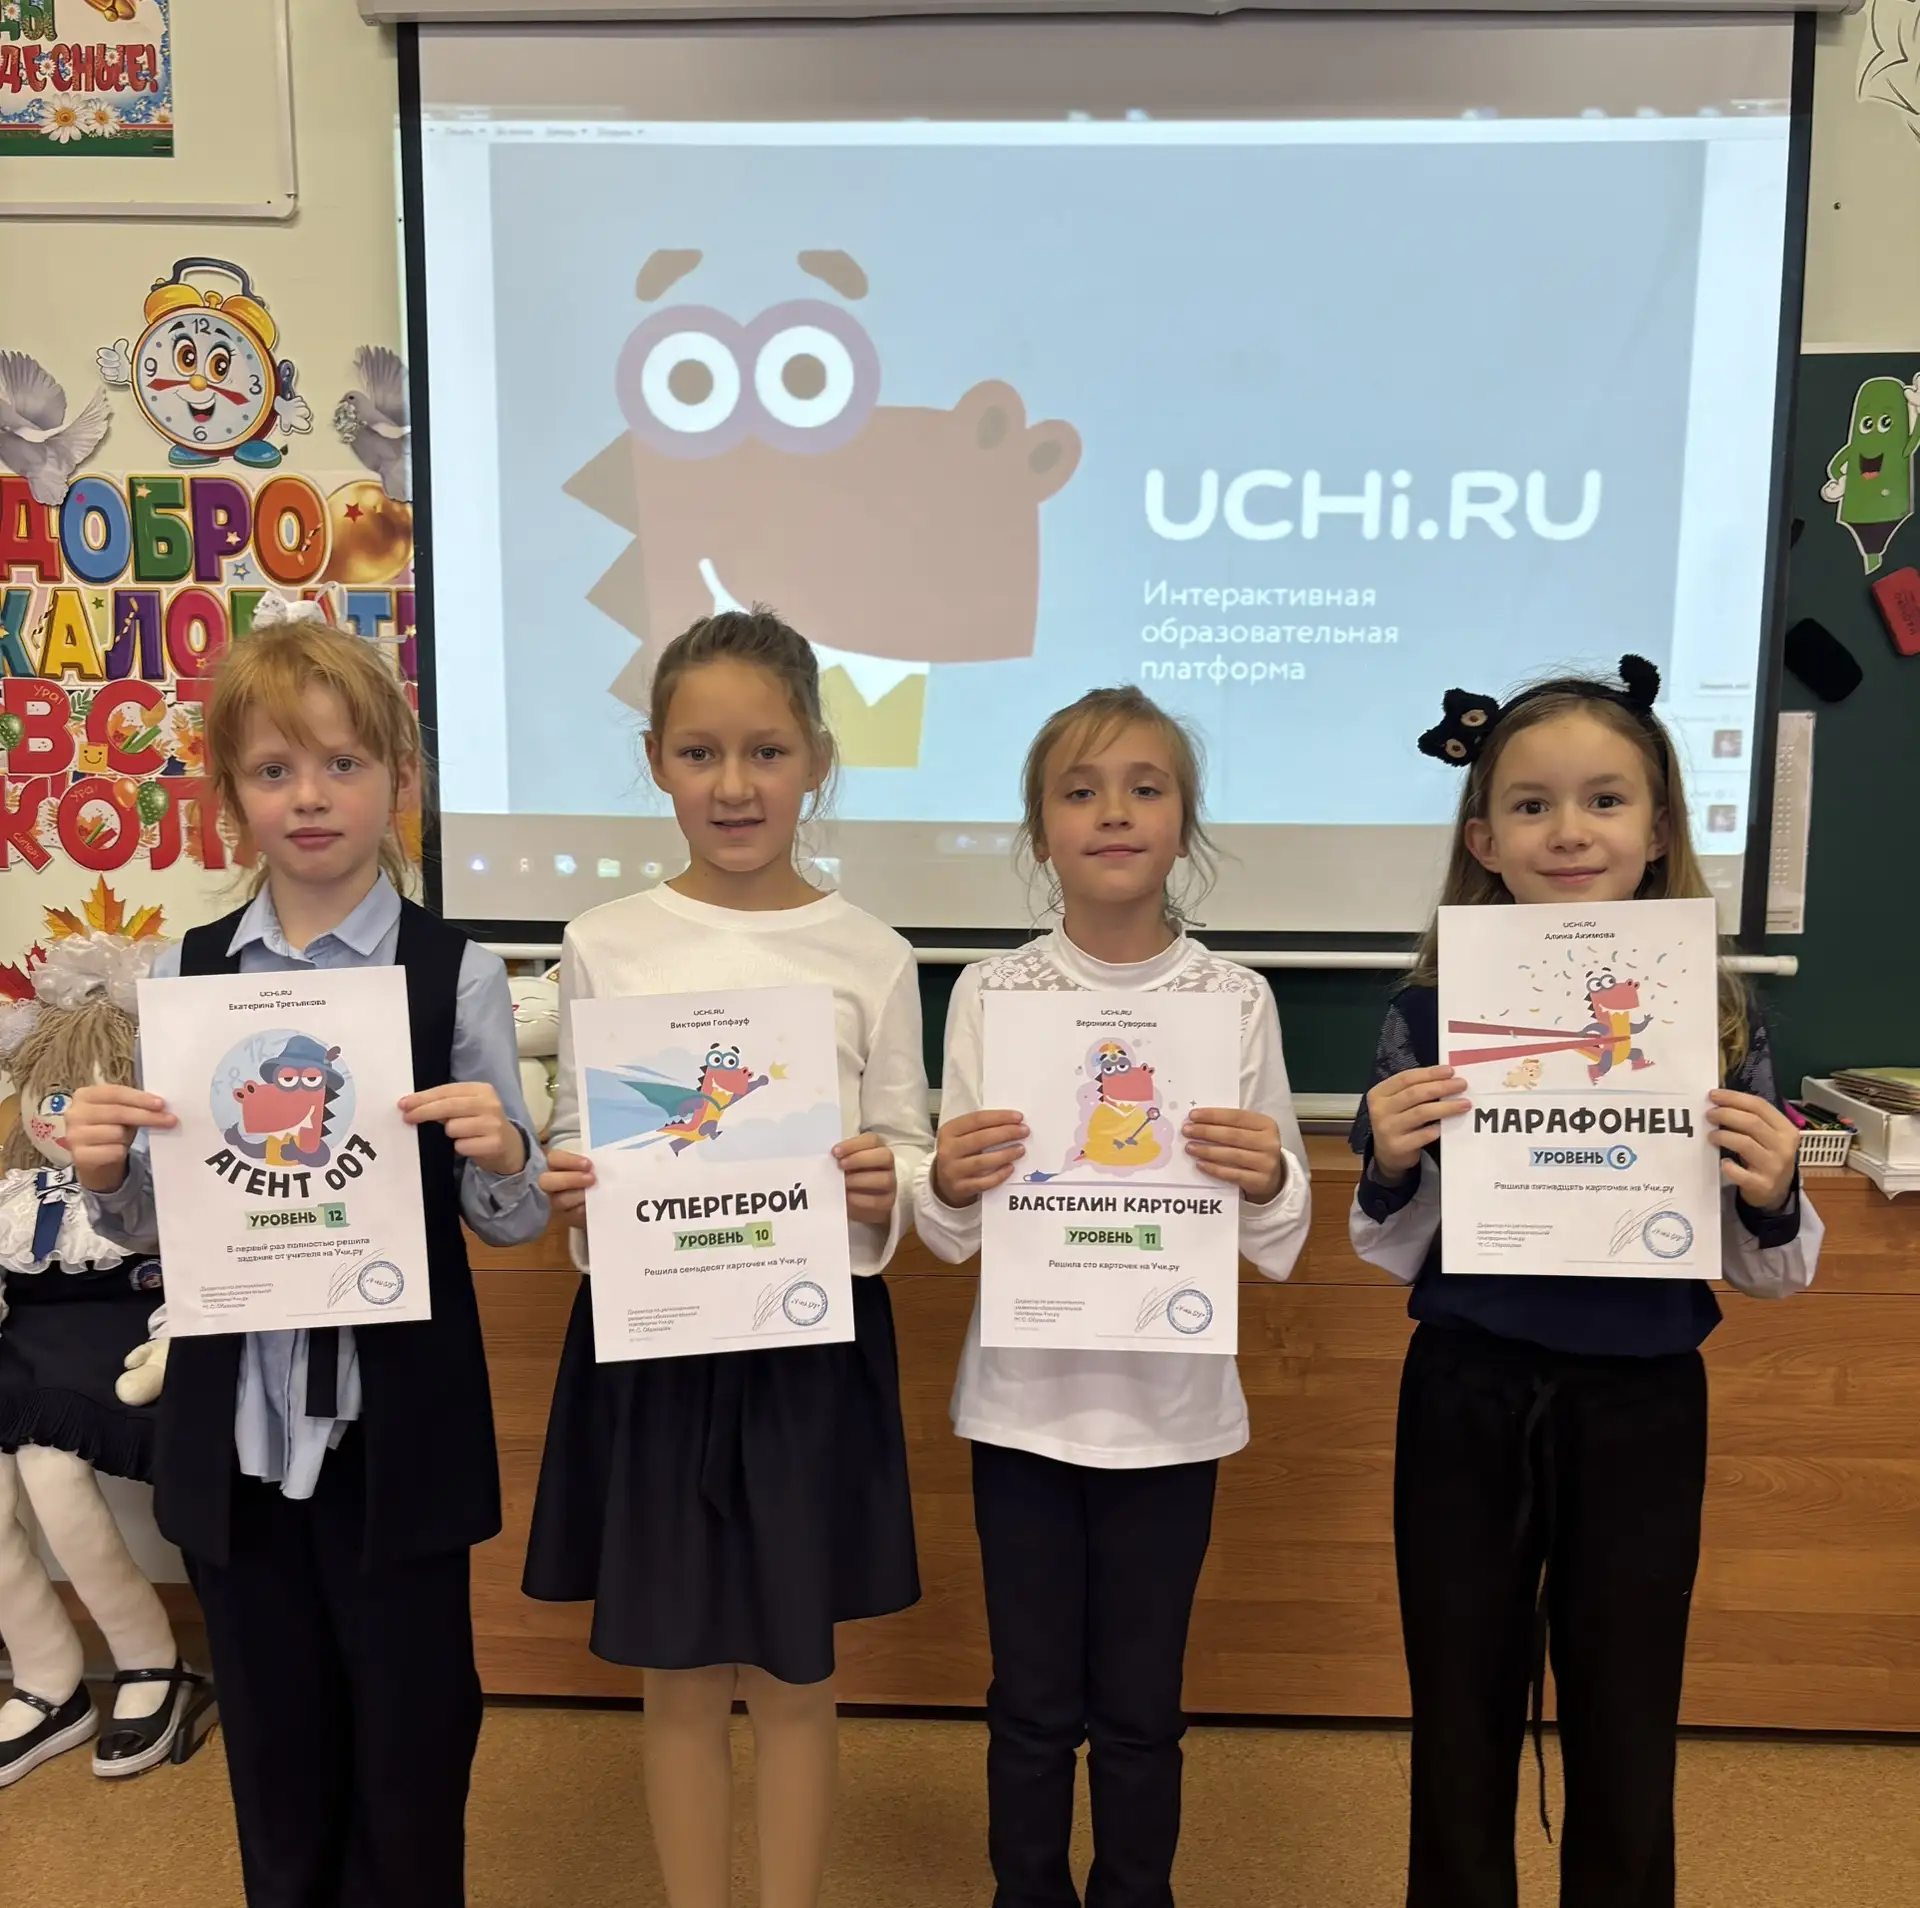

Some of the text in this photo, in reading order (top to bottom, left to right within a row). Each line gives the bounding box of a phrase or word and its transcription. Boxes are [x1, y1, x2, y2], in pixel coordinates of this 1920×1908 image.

[192, 317, 211, 335] 12
[144, 357, 158, 377] 9
[249, 374, 262, 395] 3
[193, 426, 208, 441] 6
[0, 475, 327, 585] ДОБРО
[1143, 578, 1377, 610] Интерактивная
[1141, 617, 1399, 649] образовательная
[1139, 655, 1306, 686] платформа
[228, 1002, 275, 1011] Екатерина
[670, 1021, 712, 1029] Виктория
[1473, 1107, 1694, 1138] МАРАФОНЕЦ
[204, 1133, 378, 1198] АГЕНТ 007
[1533, 1150, 1626, 1165] УРОВЕНЬ 6
[635, 1182, 809, 1223] СУПЕРГЕРОЙ
[1008, 1194, 1223, 1215] ВЛАСТЕЛИН КАРТОЧЕК
[250, 1210, 344, 1227] УРОВЕНЬ 12
[678, 1229, 770, 1248] УРОВЕНЬ 10
[1068, 1230, 1156, 1245] УРОВЕНЬ 11
[644, 1267, 678, 1276] Решила
[679, 1264, 725, 1273] семьдесят
[726, 1260, 766, 1270] карточек
[779, 1256, 808, 1265] Учи.ру
[1048, 1259, 1082, 1268] Решила
